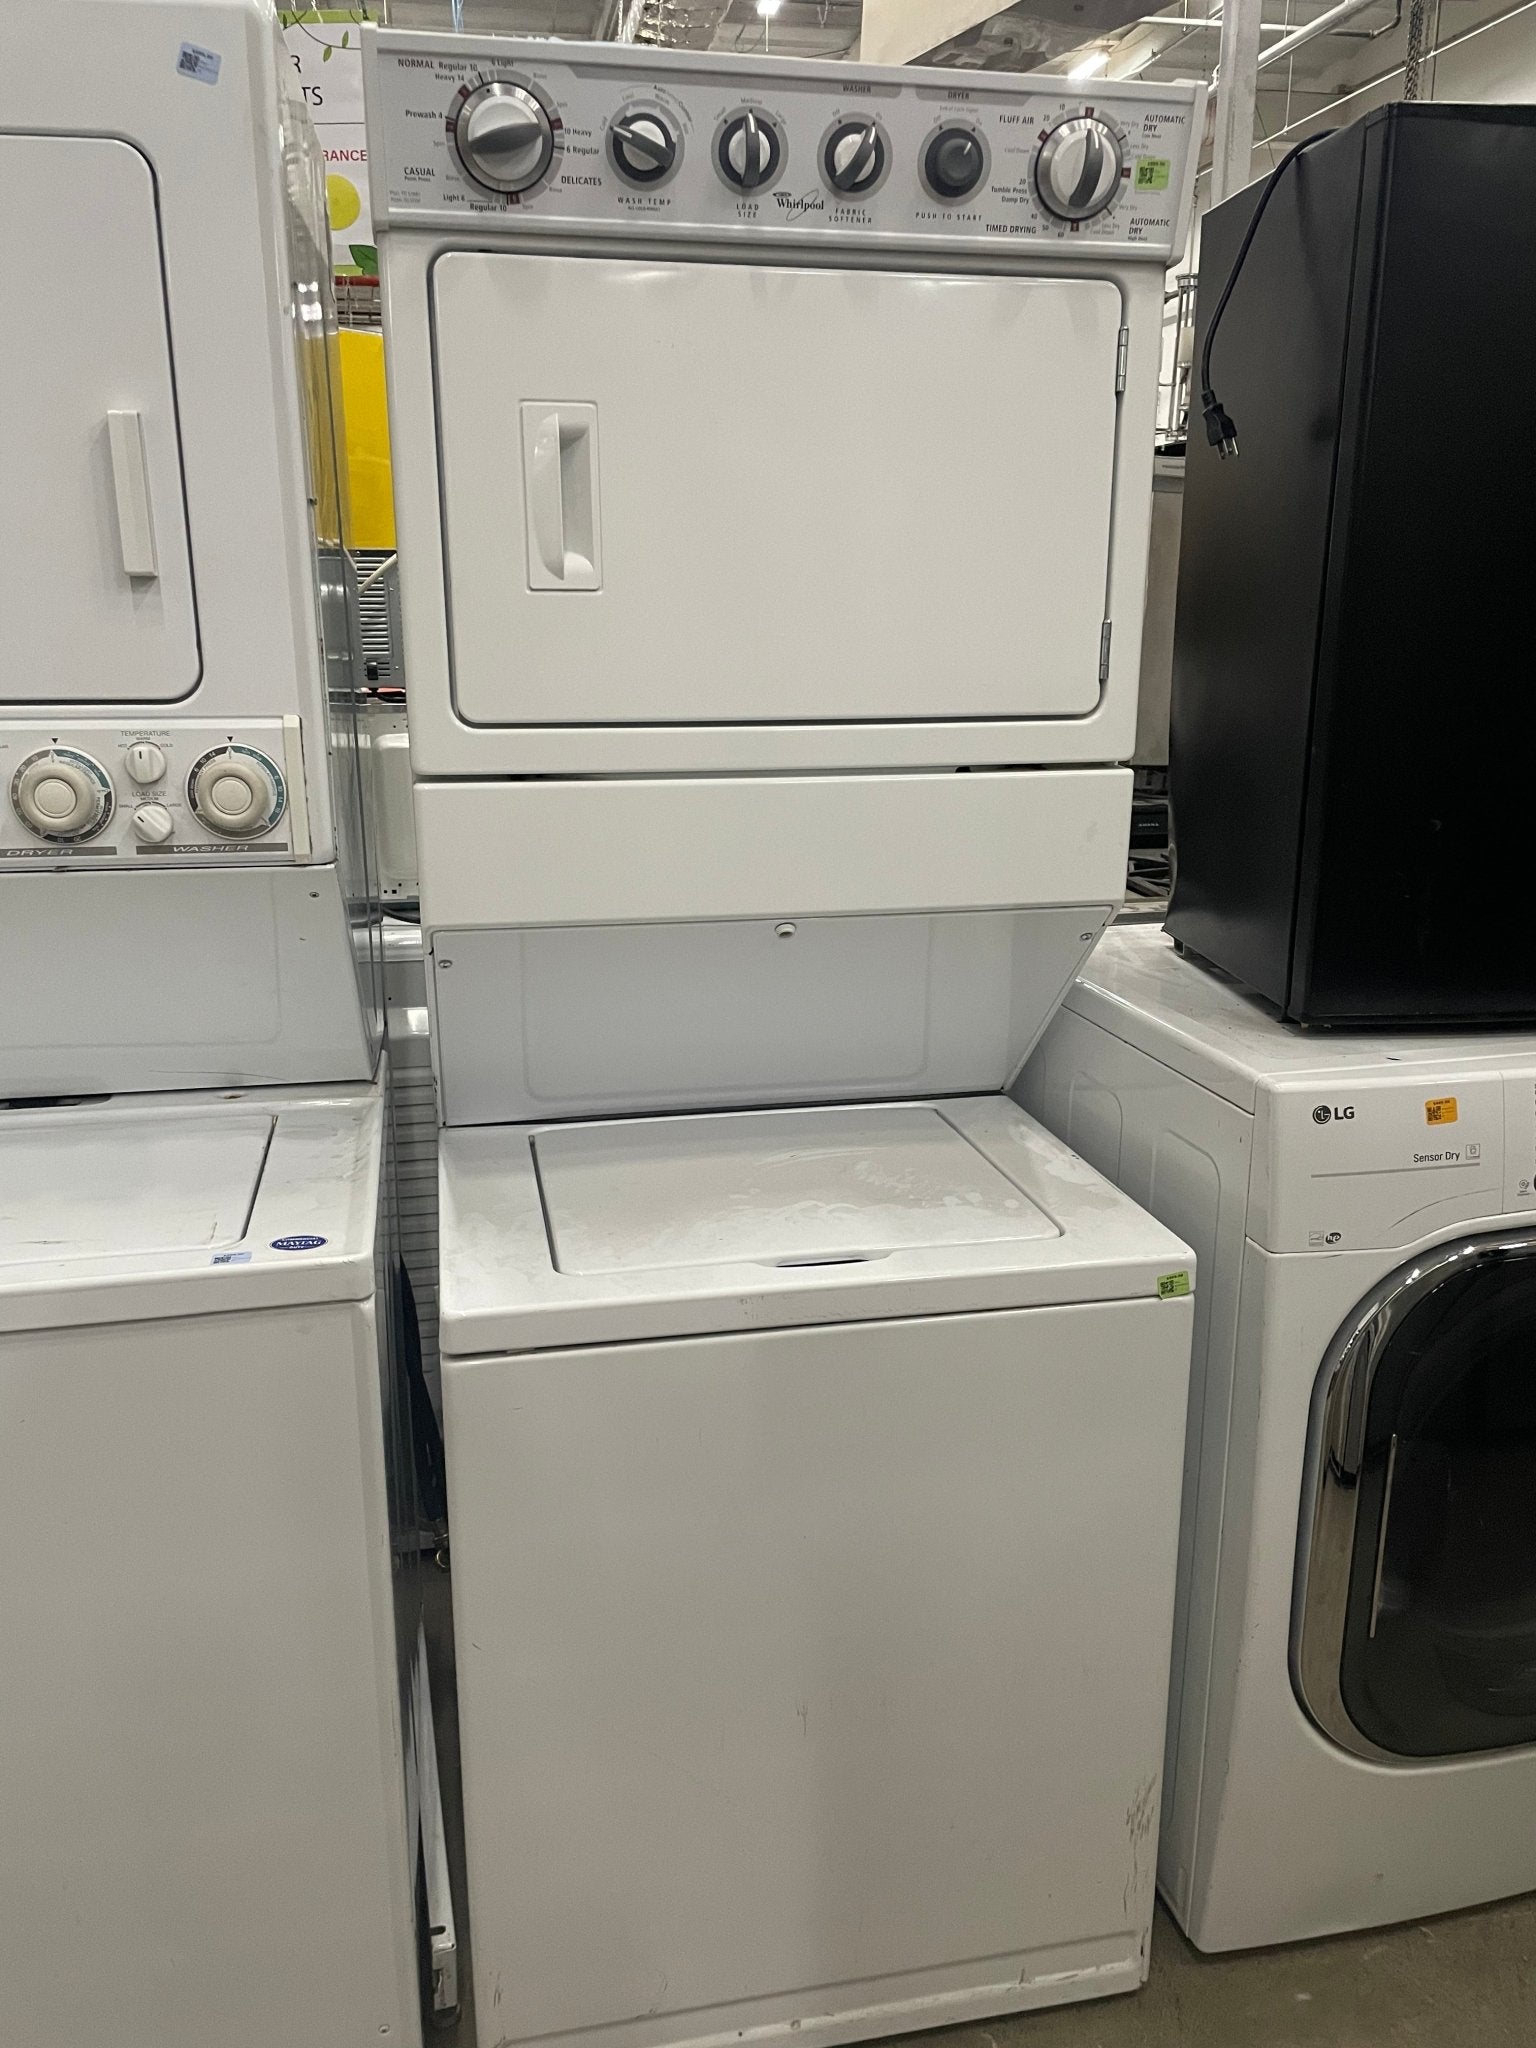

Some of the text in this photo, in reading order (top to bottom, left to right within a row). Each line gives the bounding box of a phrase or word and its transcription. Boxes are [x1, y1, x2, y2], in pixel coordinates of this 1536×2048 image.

[397, 58, 478, 72] NORMAL Regular 10
[435, 73, 455, 83] Heavy
[842, 84, 872, 93] WASHER
[947, 91, 970, 100] DRYER
[1059, 103, 1066, 111] 10
[405, 109, 443, 119] Prewash 4
[999, 114, 1035, 125] FLUFF AIR
[1144, 114, 1185, 125] AUTOMATIC
[572, 128, 592, 138] Heavy
[1143, 124, 1158, 132] DRY
[572, 145, 600, 156] Regular
[404, 167, 435, 177] CASUAL
[561, 175, 602, 186] DELICATES
[991, 186, 1028, 194] Tumble Press
[443, 193, 460, 203] Light
[617, 197, 672, 206] WASH TEMP
[1001, 195, 1029, 205] Damp Dry
[469, 202, 507, 213] Regular 10
[736, 202, 760, 211] LOAD
[776, 198, 824, 212] Whirlpool
[737, 211, 757, 219] SIZE
[835, 207, 867, 217] FABRIC
[915, 211, 982, 222] PUSH TO START
[828, 215, 873, 224] SOFTENER
[1129, 217, 1170, 227] AUTOMATIC
[986, 223, 1037, 234] TIMED DRYING
[1128, 226, 1143, 235] DRY
[6, 848, 74, 857] DRYER
[172, 845, 249, 853] WASHER
[1334, 1106, 1355, 1120] LG
[1413, 1151, 1461, 1163] Sensor Dry
